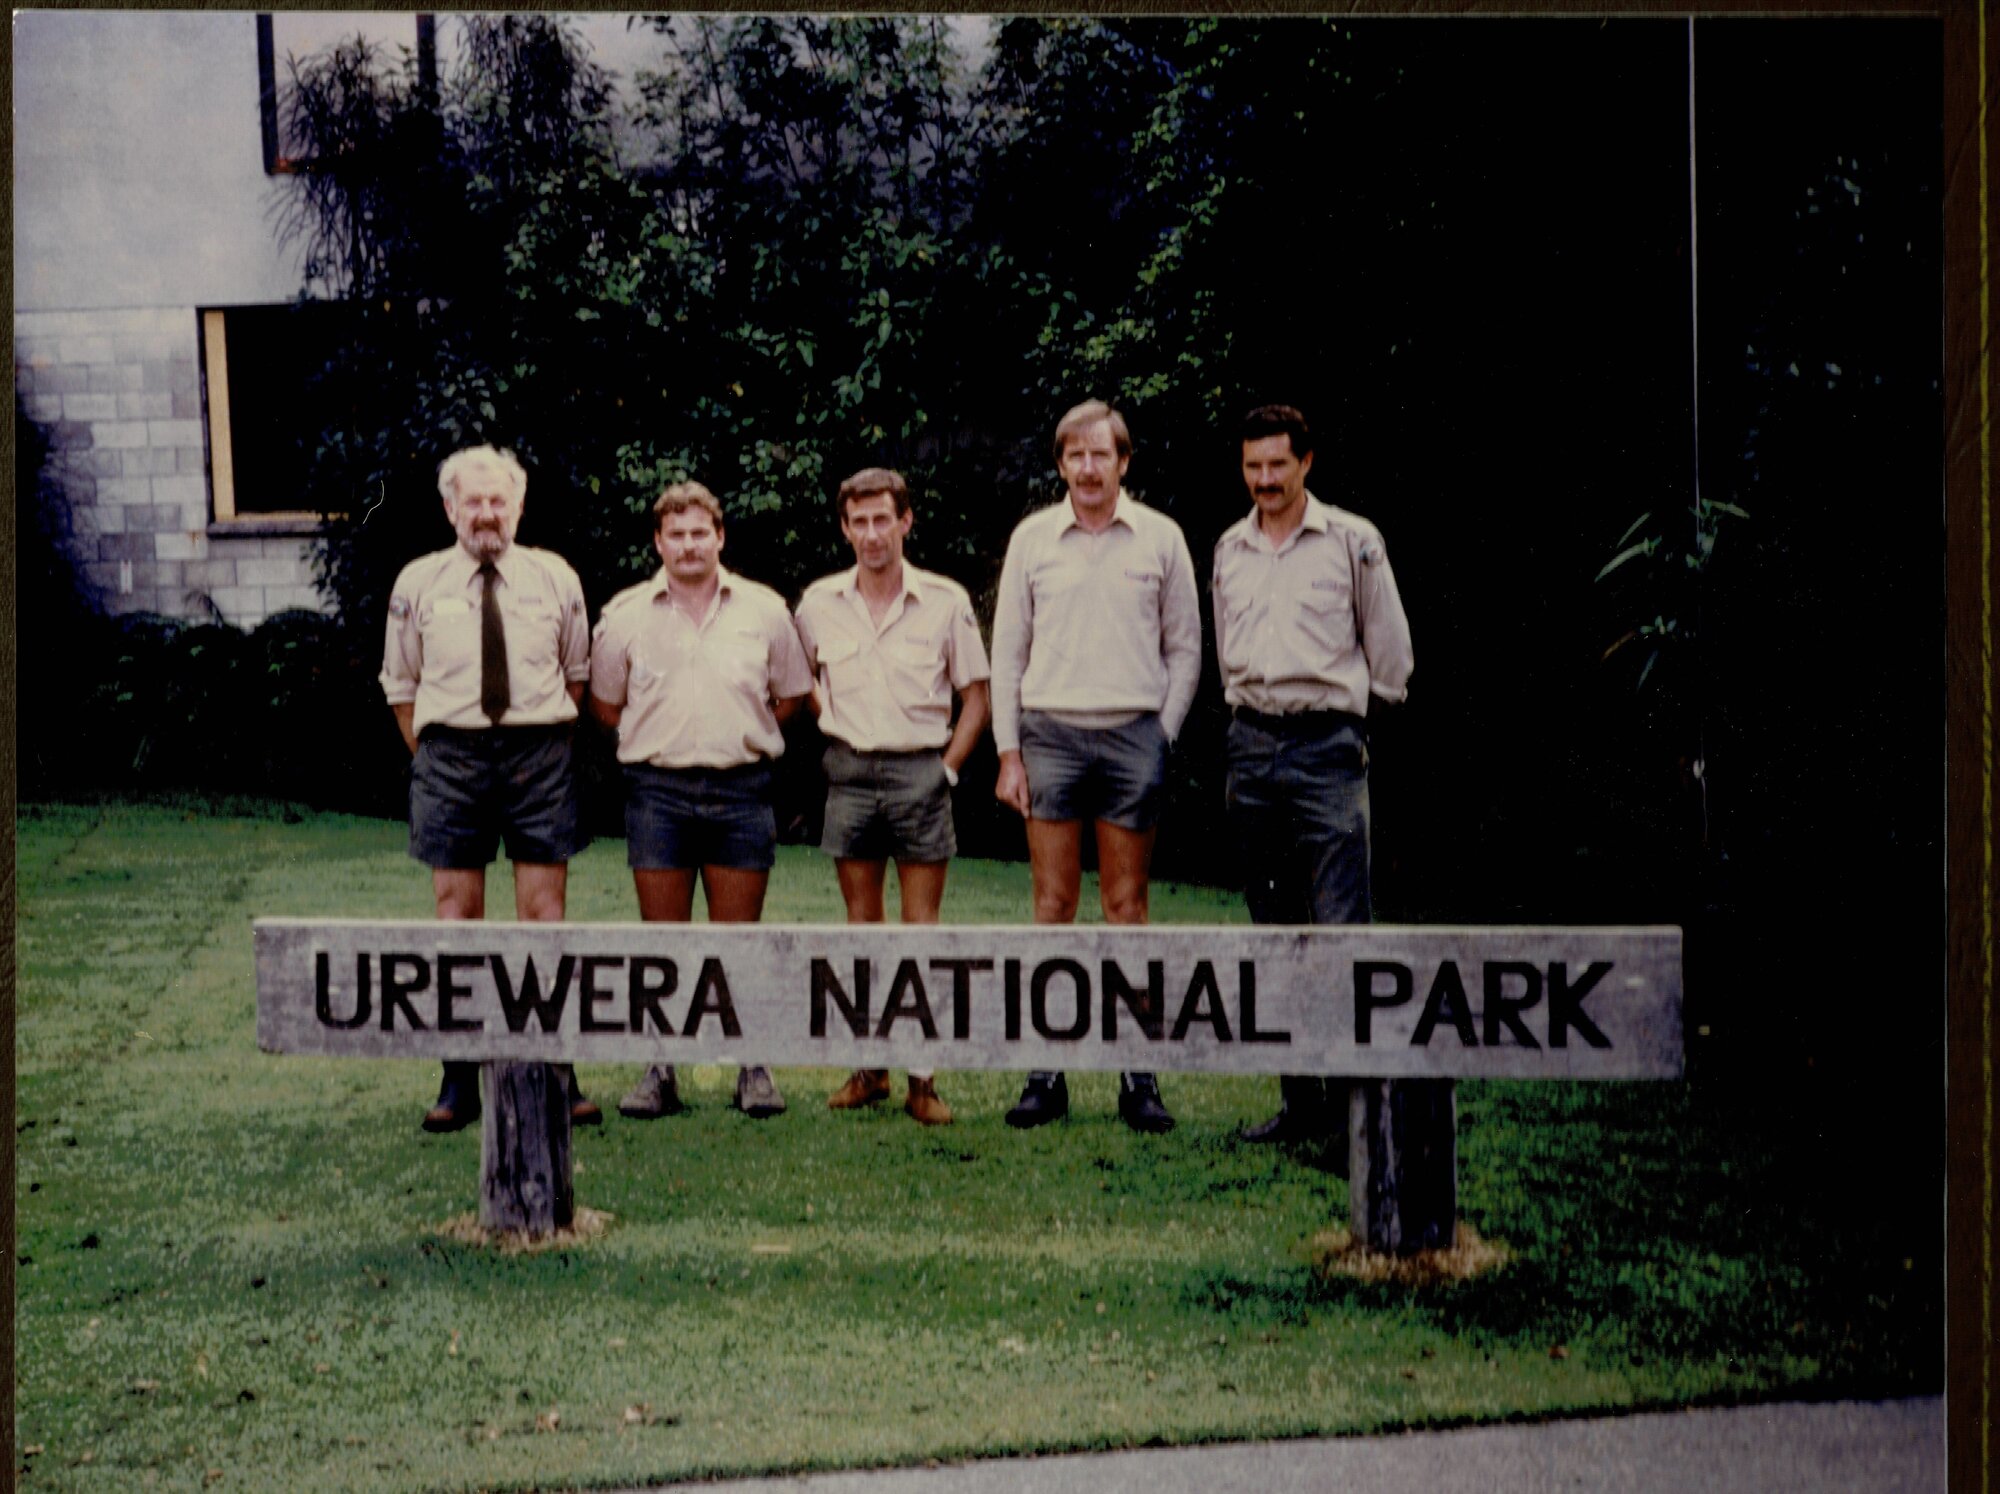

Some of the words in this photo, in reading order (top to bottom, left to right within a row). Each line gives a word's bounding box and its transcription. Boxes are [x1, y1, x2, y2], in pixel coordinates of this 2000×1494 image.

[315, 951, 742, 1038] UREWERA
[810, 957, 1291, 1042] NATIONAL
[1353, 960, 1614, 1049] PARK
